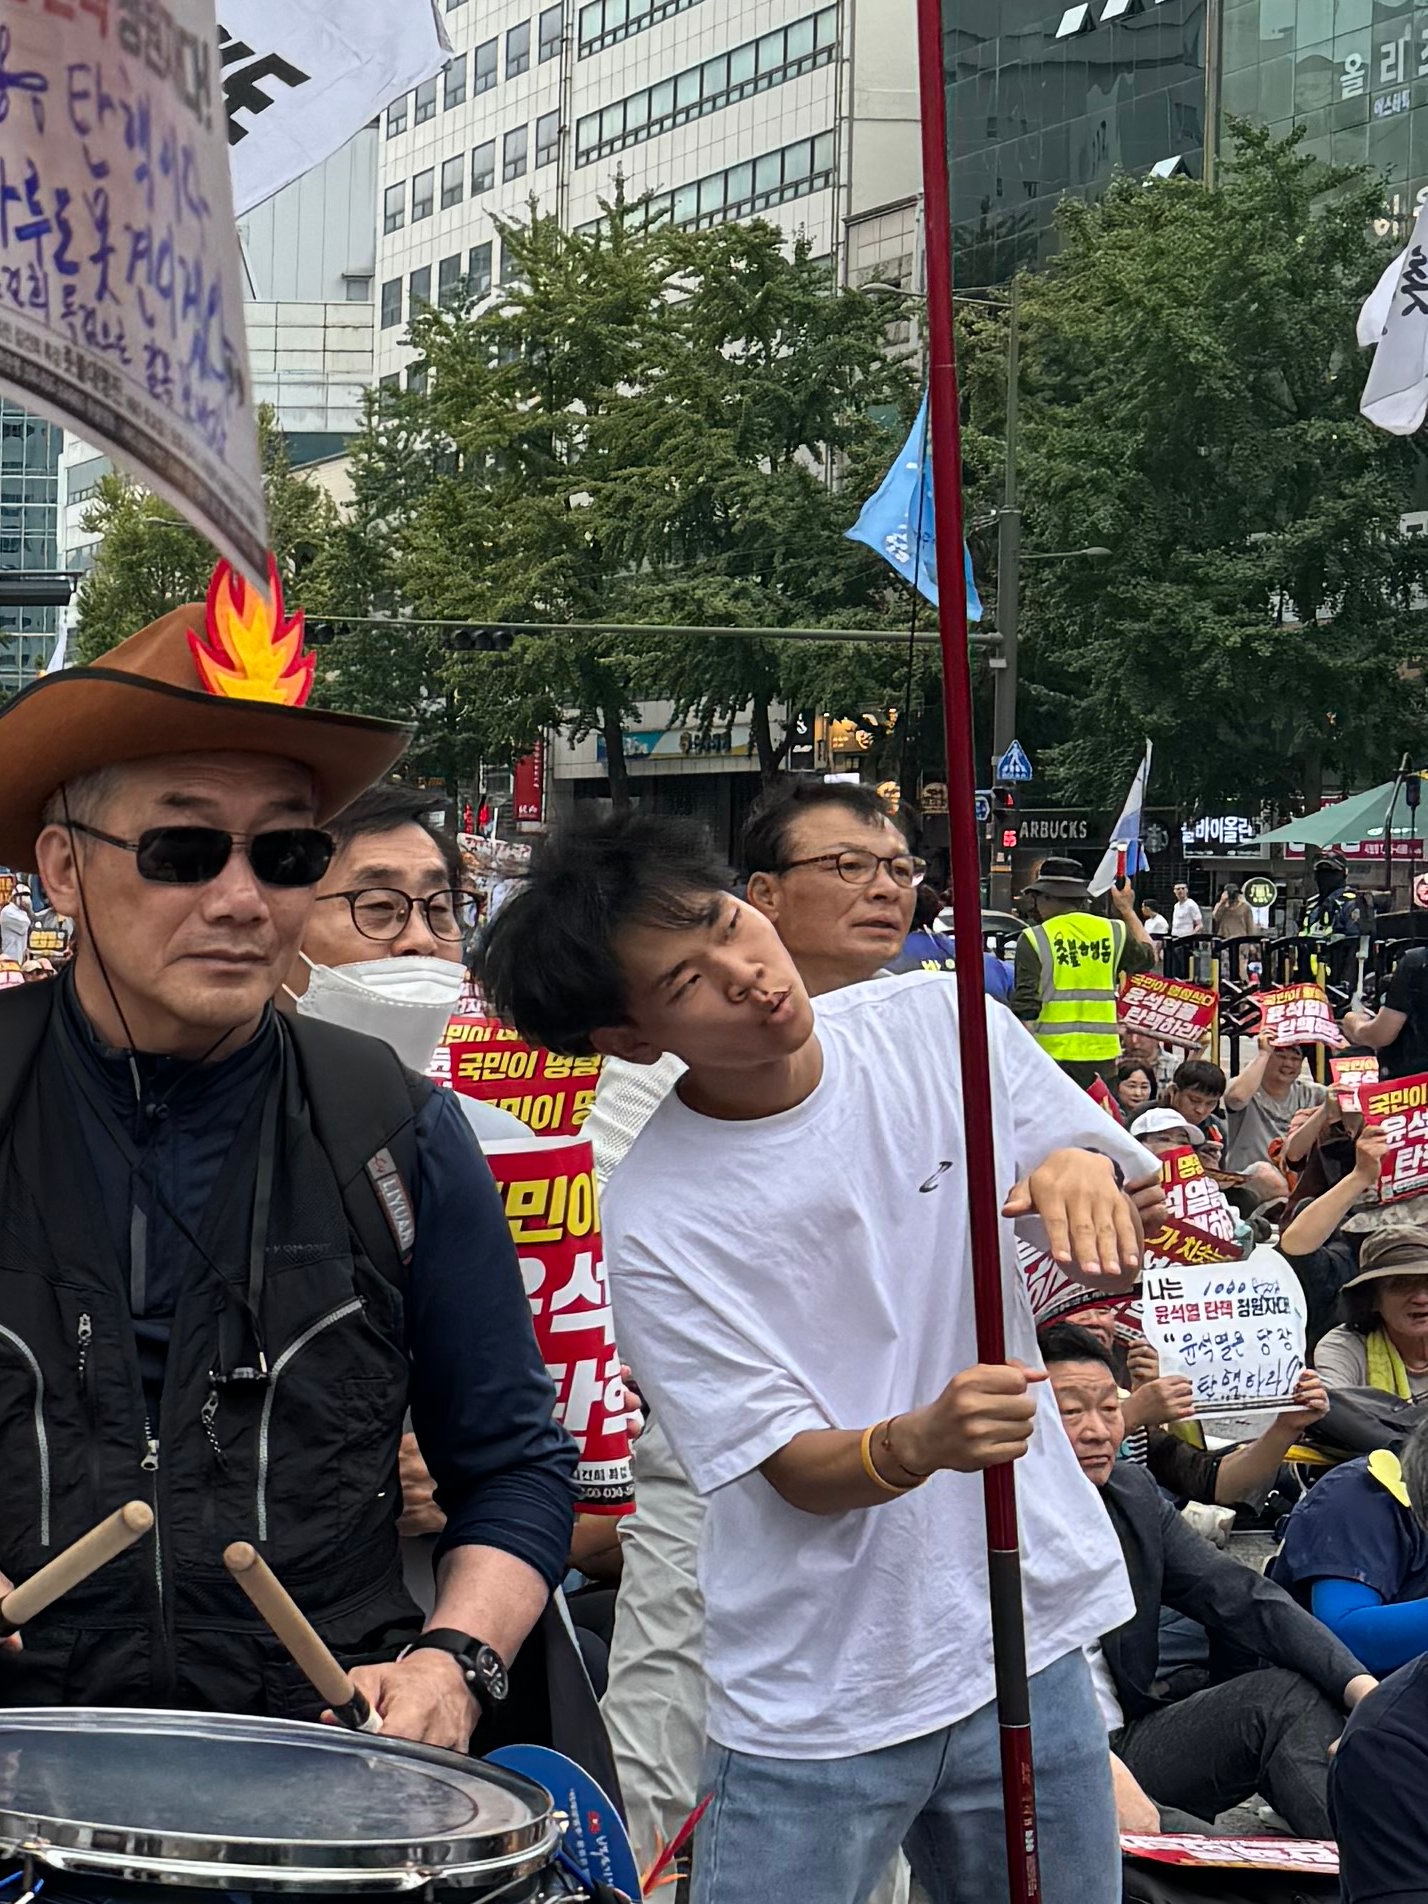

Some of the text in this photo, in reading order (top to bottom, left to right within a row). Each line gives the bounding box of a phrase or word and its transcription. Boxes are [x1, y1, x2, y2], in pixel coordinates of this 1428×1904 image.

[1018, 819, 1089, 840] ARBUCKS
[1120, 986, 1200, 1022] 윤석열을
[457, 1051, 606, 1082] 국민이 명령
[486, 1093, 565, 1134] 민이
[1366, 1083, 1428, 1116] 국민이
[499, 1169, 602, 1244] 민이
[1147, 1278, 1184, 1301] 나는
[1155, 1302, 1200, 1326] 윤석열
[1204, 1300, 1234, 1320] 탄핵
[1255, 1326, 1294, 1358] 당장
